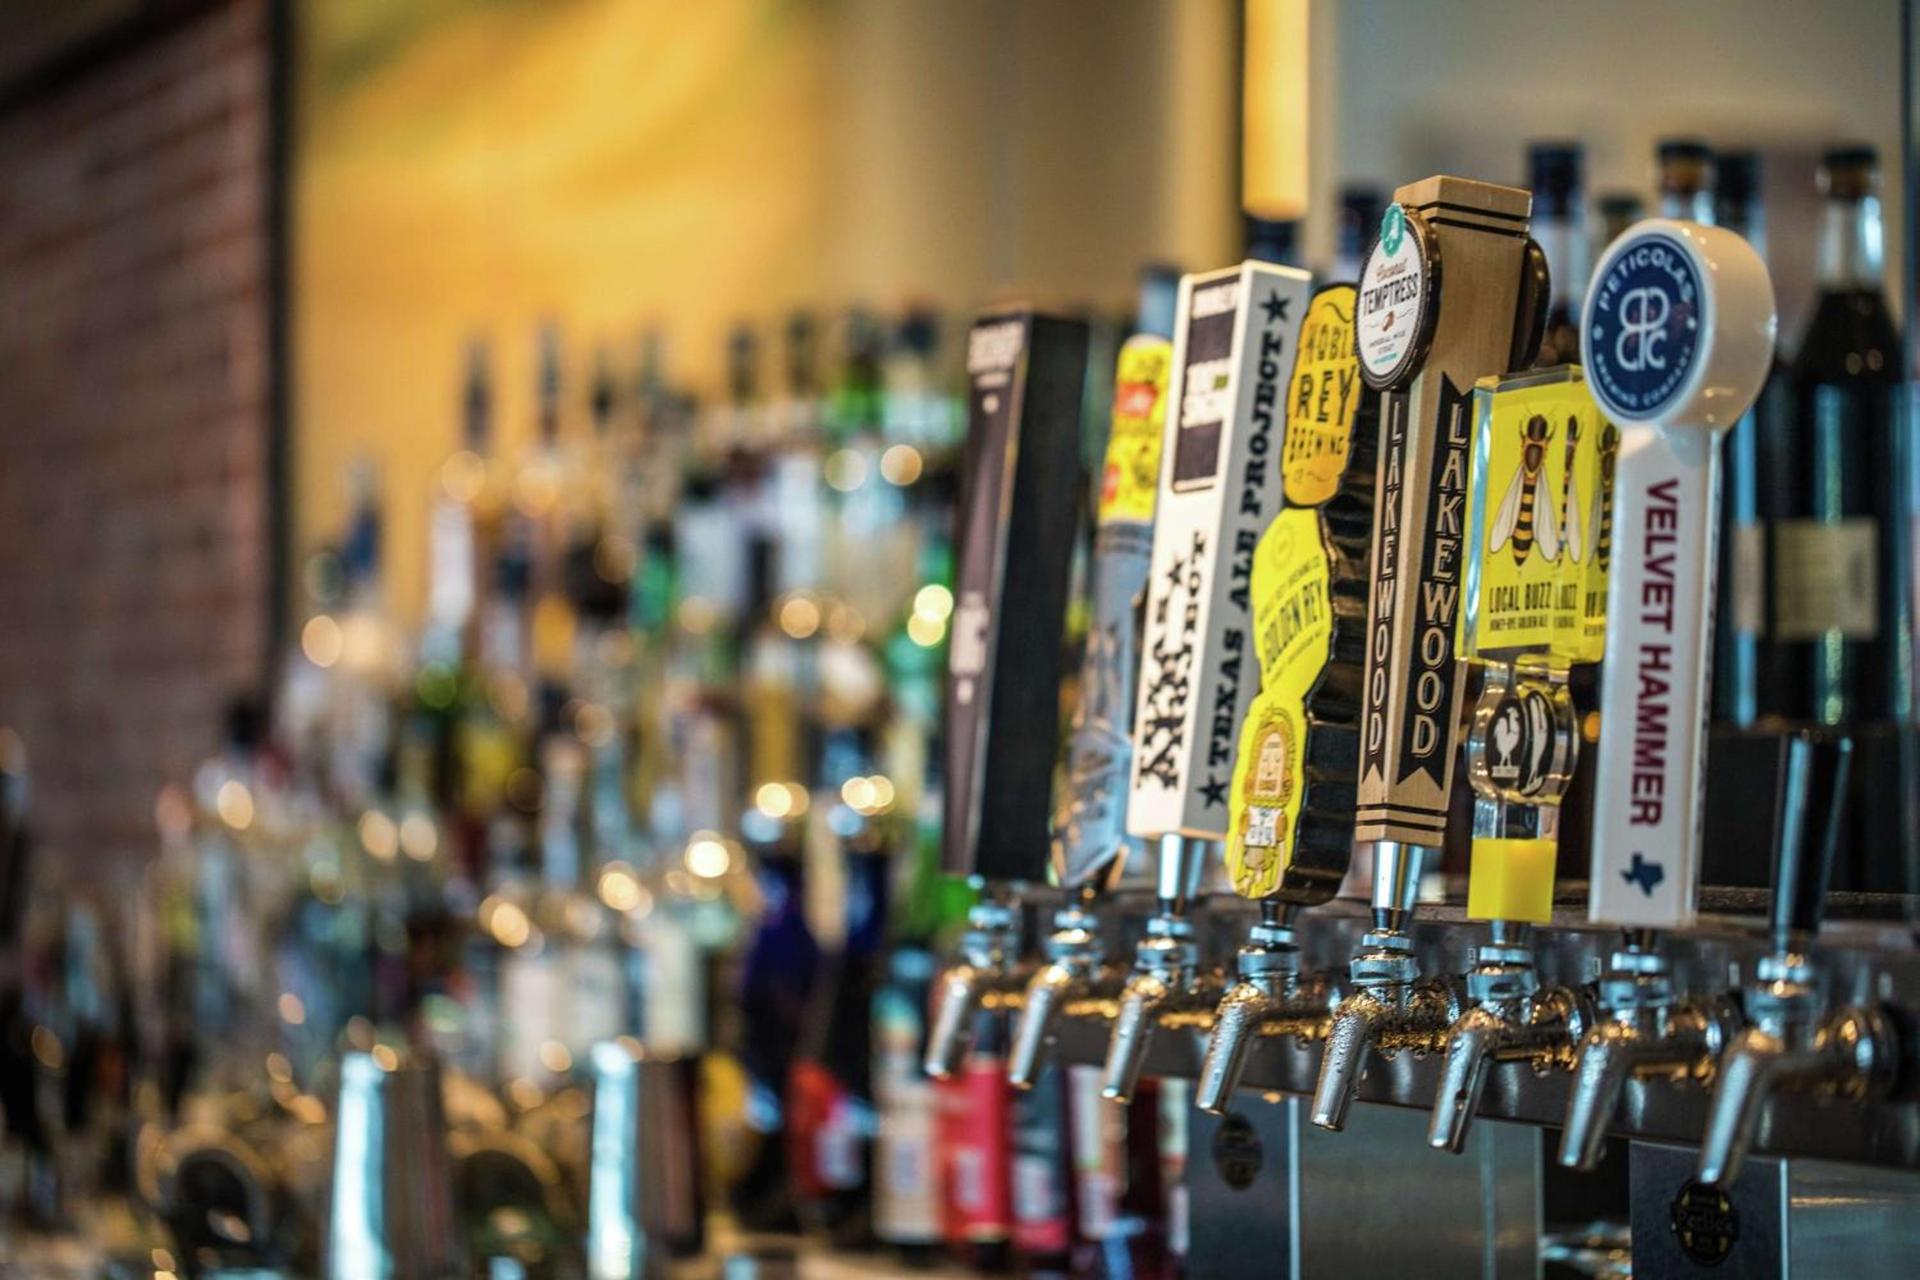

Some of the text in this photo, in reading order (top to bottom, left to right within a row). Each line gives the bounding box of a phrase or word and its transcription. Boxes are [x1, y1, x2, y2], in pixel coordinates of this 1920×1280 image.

[1363, 273, 1418, 317] TEMPTRESS
[1599, 248, 1693, 311] PETICOLAS
[1295, 365, 1356, 427] REY
[1209, 331, 1283, 767] TEXAS ALE PROJECT
[1369, 401, 1402, 755] LAKEWOOD
[1411, 402, 1468, 758] LAKEWOOD
[1489, 585, 1519, 613] LOCAL
[1525, 581, 1551, 610] BUZZ
[1630, 478, 1680, 827] VELVET HAMMER
